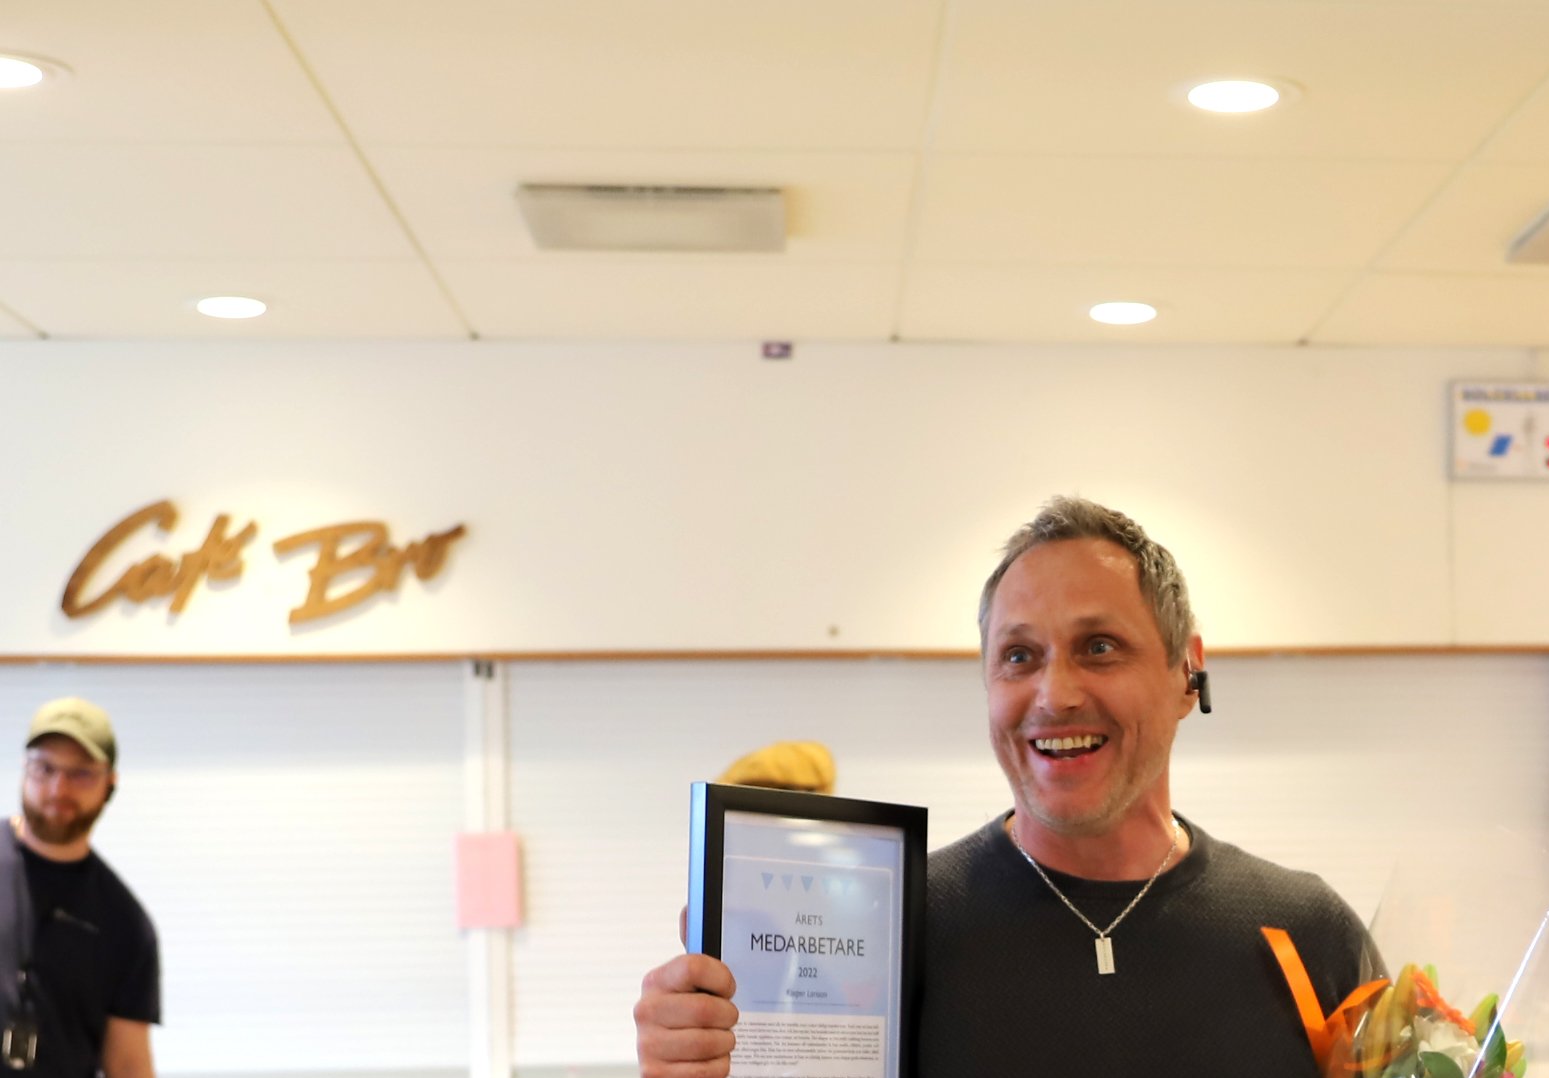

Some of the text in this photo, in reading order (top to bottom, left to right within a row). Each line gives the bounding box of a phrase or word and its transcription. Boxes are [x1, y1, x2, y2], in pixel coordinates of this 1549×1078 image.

[61, 500, 467, 624] Café Bro
[795, 912, 823, 927] ÅRETS
[750, 932, 865, 957] MEDARBETARE
[798, 967, 818, 979] 2022
